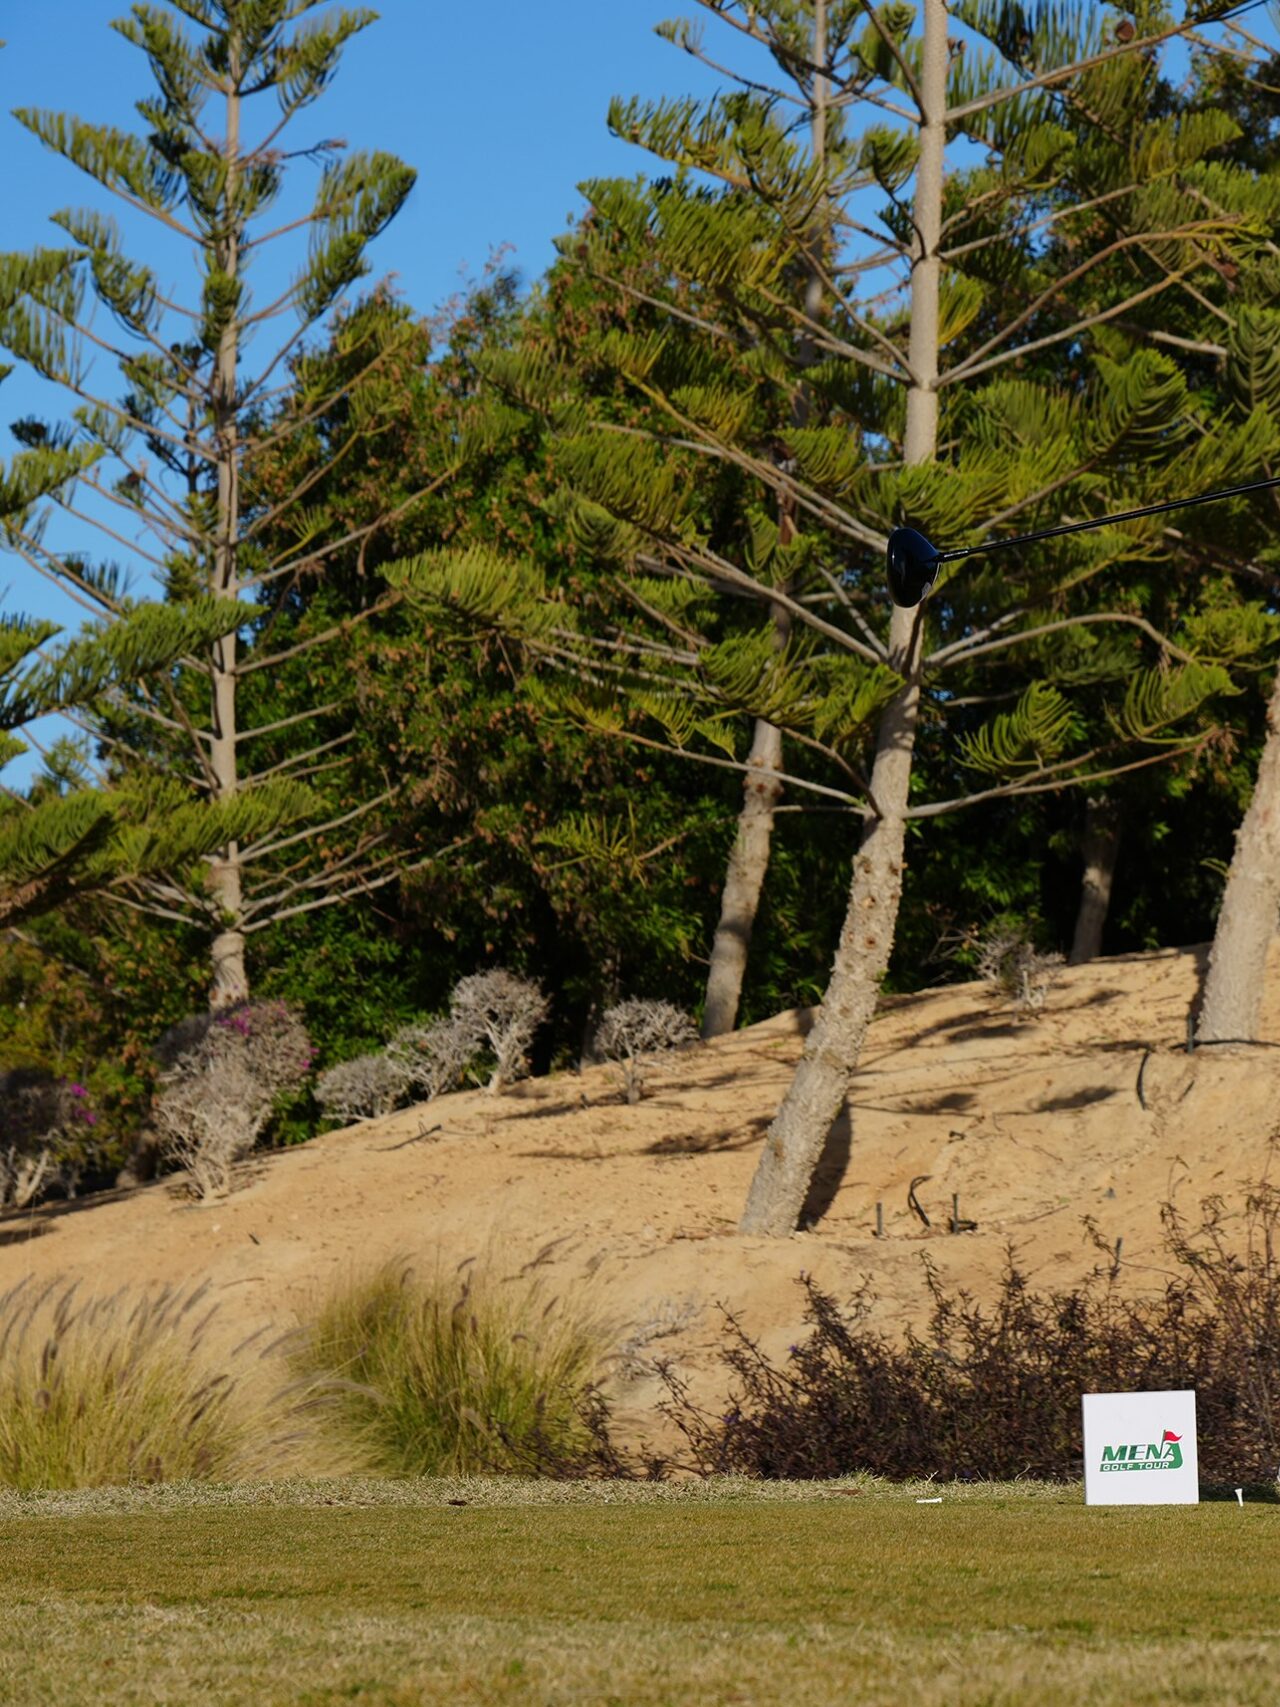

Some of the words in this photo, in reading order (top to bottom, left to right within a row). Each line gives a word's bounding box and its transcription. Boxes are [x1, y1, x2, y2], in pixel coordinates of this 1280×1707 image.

[1101, 1442, 1182, 1462] MENA
[1102, 1463, 1134, 1472] GOLF
[1138, 1461, 1170, 1470] TOUR
